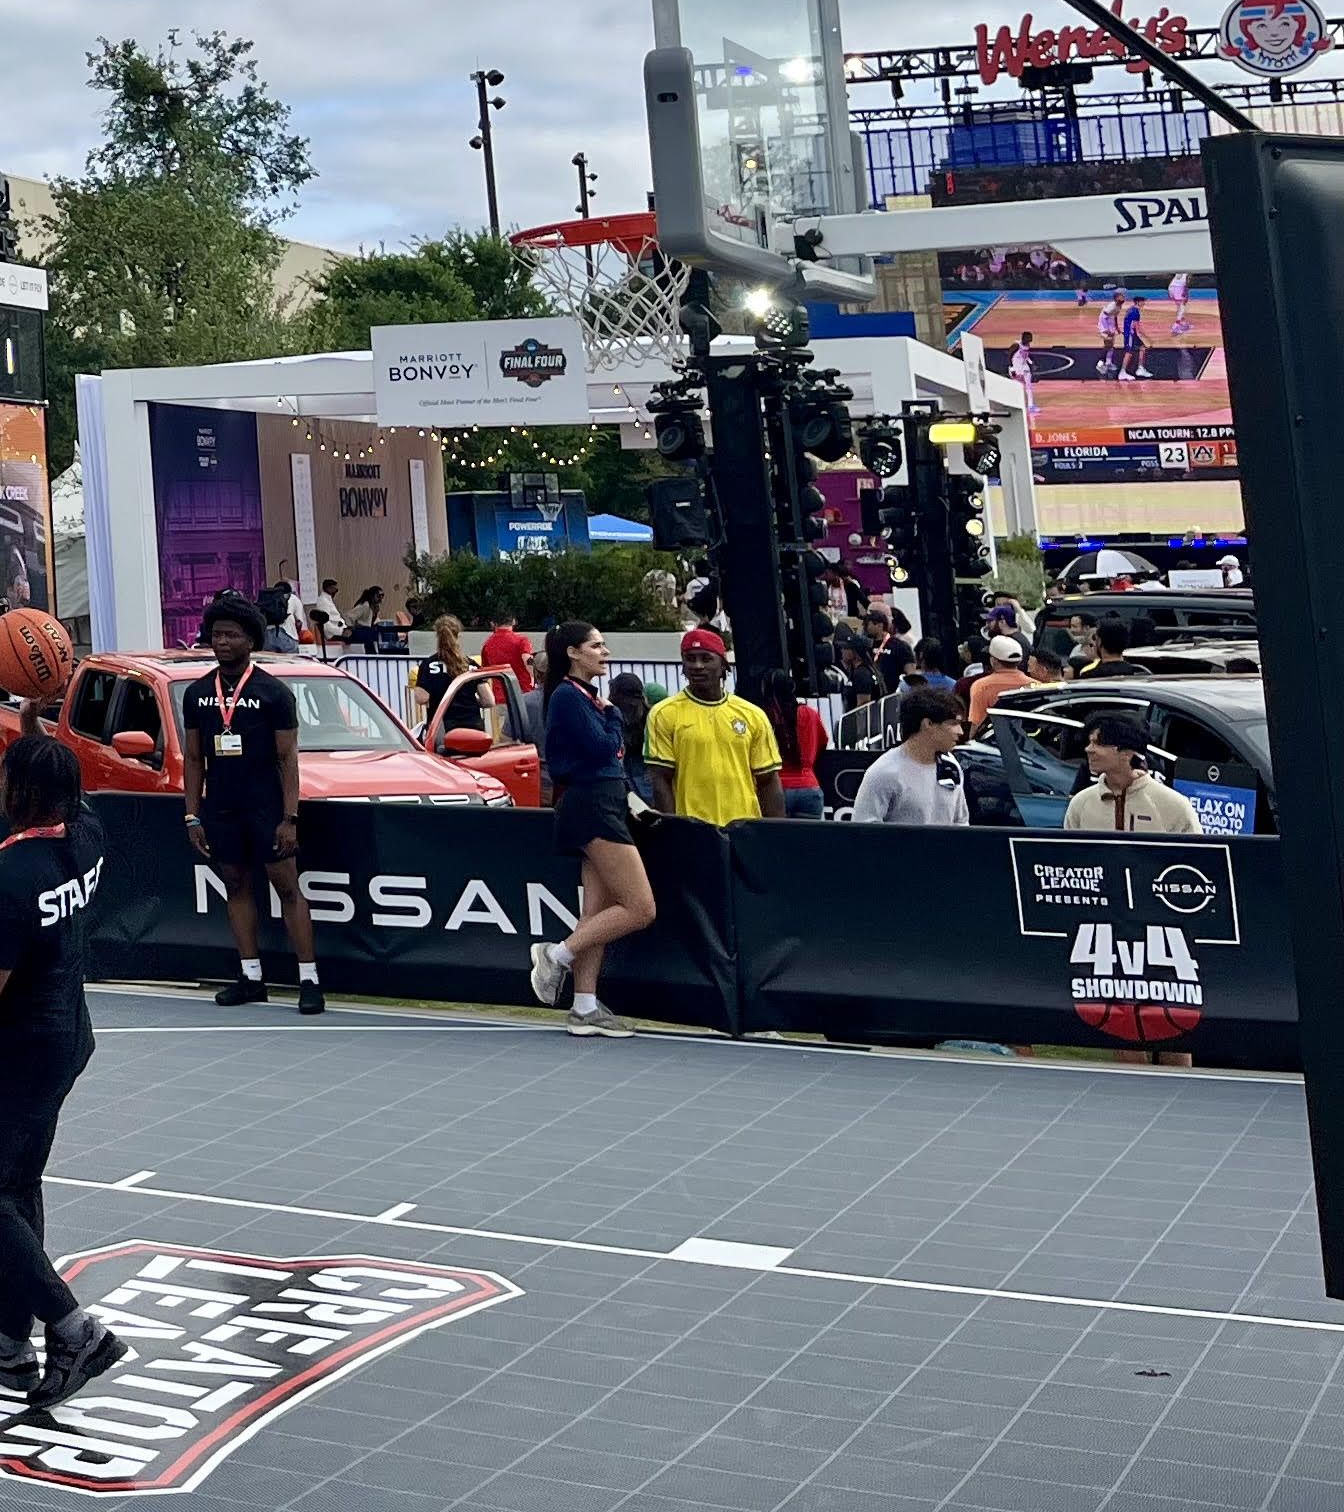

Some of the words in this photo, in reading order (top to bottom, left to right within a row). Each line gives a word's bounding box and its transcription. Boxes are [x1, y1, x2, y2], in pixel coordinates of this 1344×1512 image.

[1114, 198, 1209, 233] SPAL
[400, 353, 462, 363] MARRIOTT
[503, 356, 534, 369] FINAL
[534, 355, 563, 367] FOUR
[1047, 433, 1077, 442] JONES
[1128, 430, 1156, 440] NCAA
[1158, 429, 1195, 439] TOURN:
[1064, 447, 1108, 457] FLORIDA
[1165, 448, 1185, 463] 23
[6, 486, 28, 500] CREEK
[509, 522, 553, 531] POWERADE
[42, 621, 69, 663] NCAA
[19, 626, 52, 683] Wilson
[198, 696, 261, 710] NISSAN
[1189, 796, 1223, 816] ELAX
[1224, 802, 1246, 819] ON
[1200, 813, 1228, 828] ROAD
[1229, 817, 1243, 830] TO
[1033, 864, 1104, 879] CREATOR
[1040, 877, 1101, 892] LEAGUE
[1152, 883, 1217, 894] NISSAN
[194, 864, 586, 938] NISSAN
[1035, 894, 1109, 906] PRESENTS
[1071, 977, 1204, 1006] SHOWDOWN
